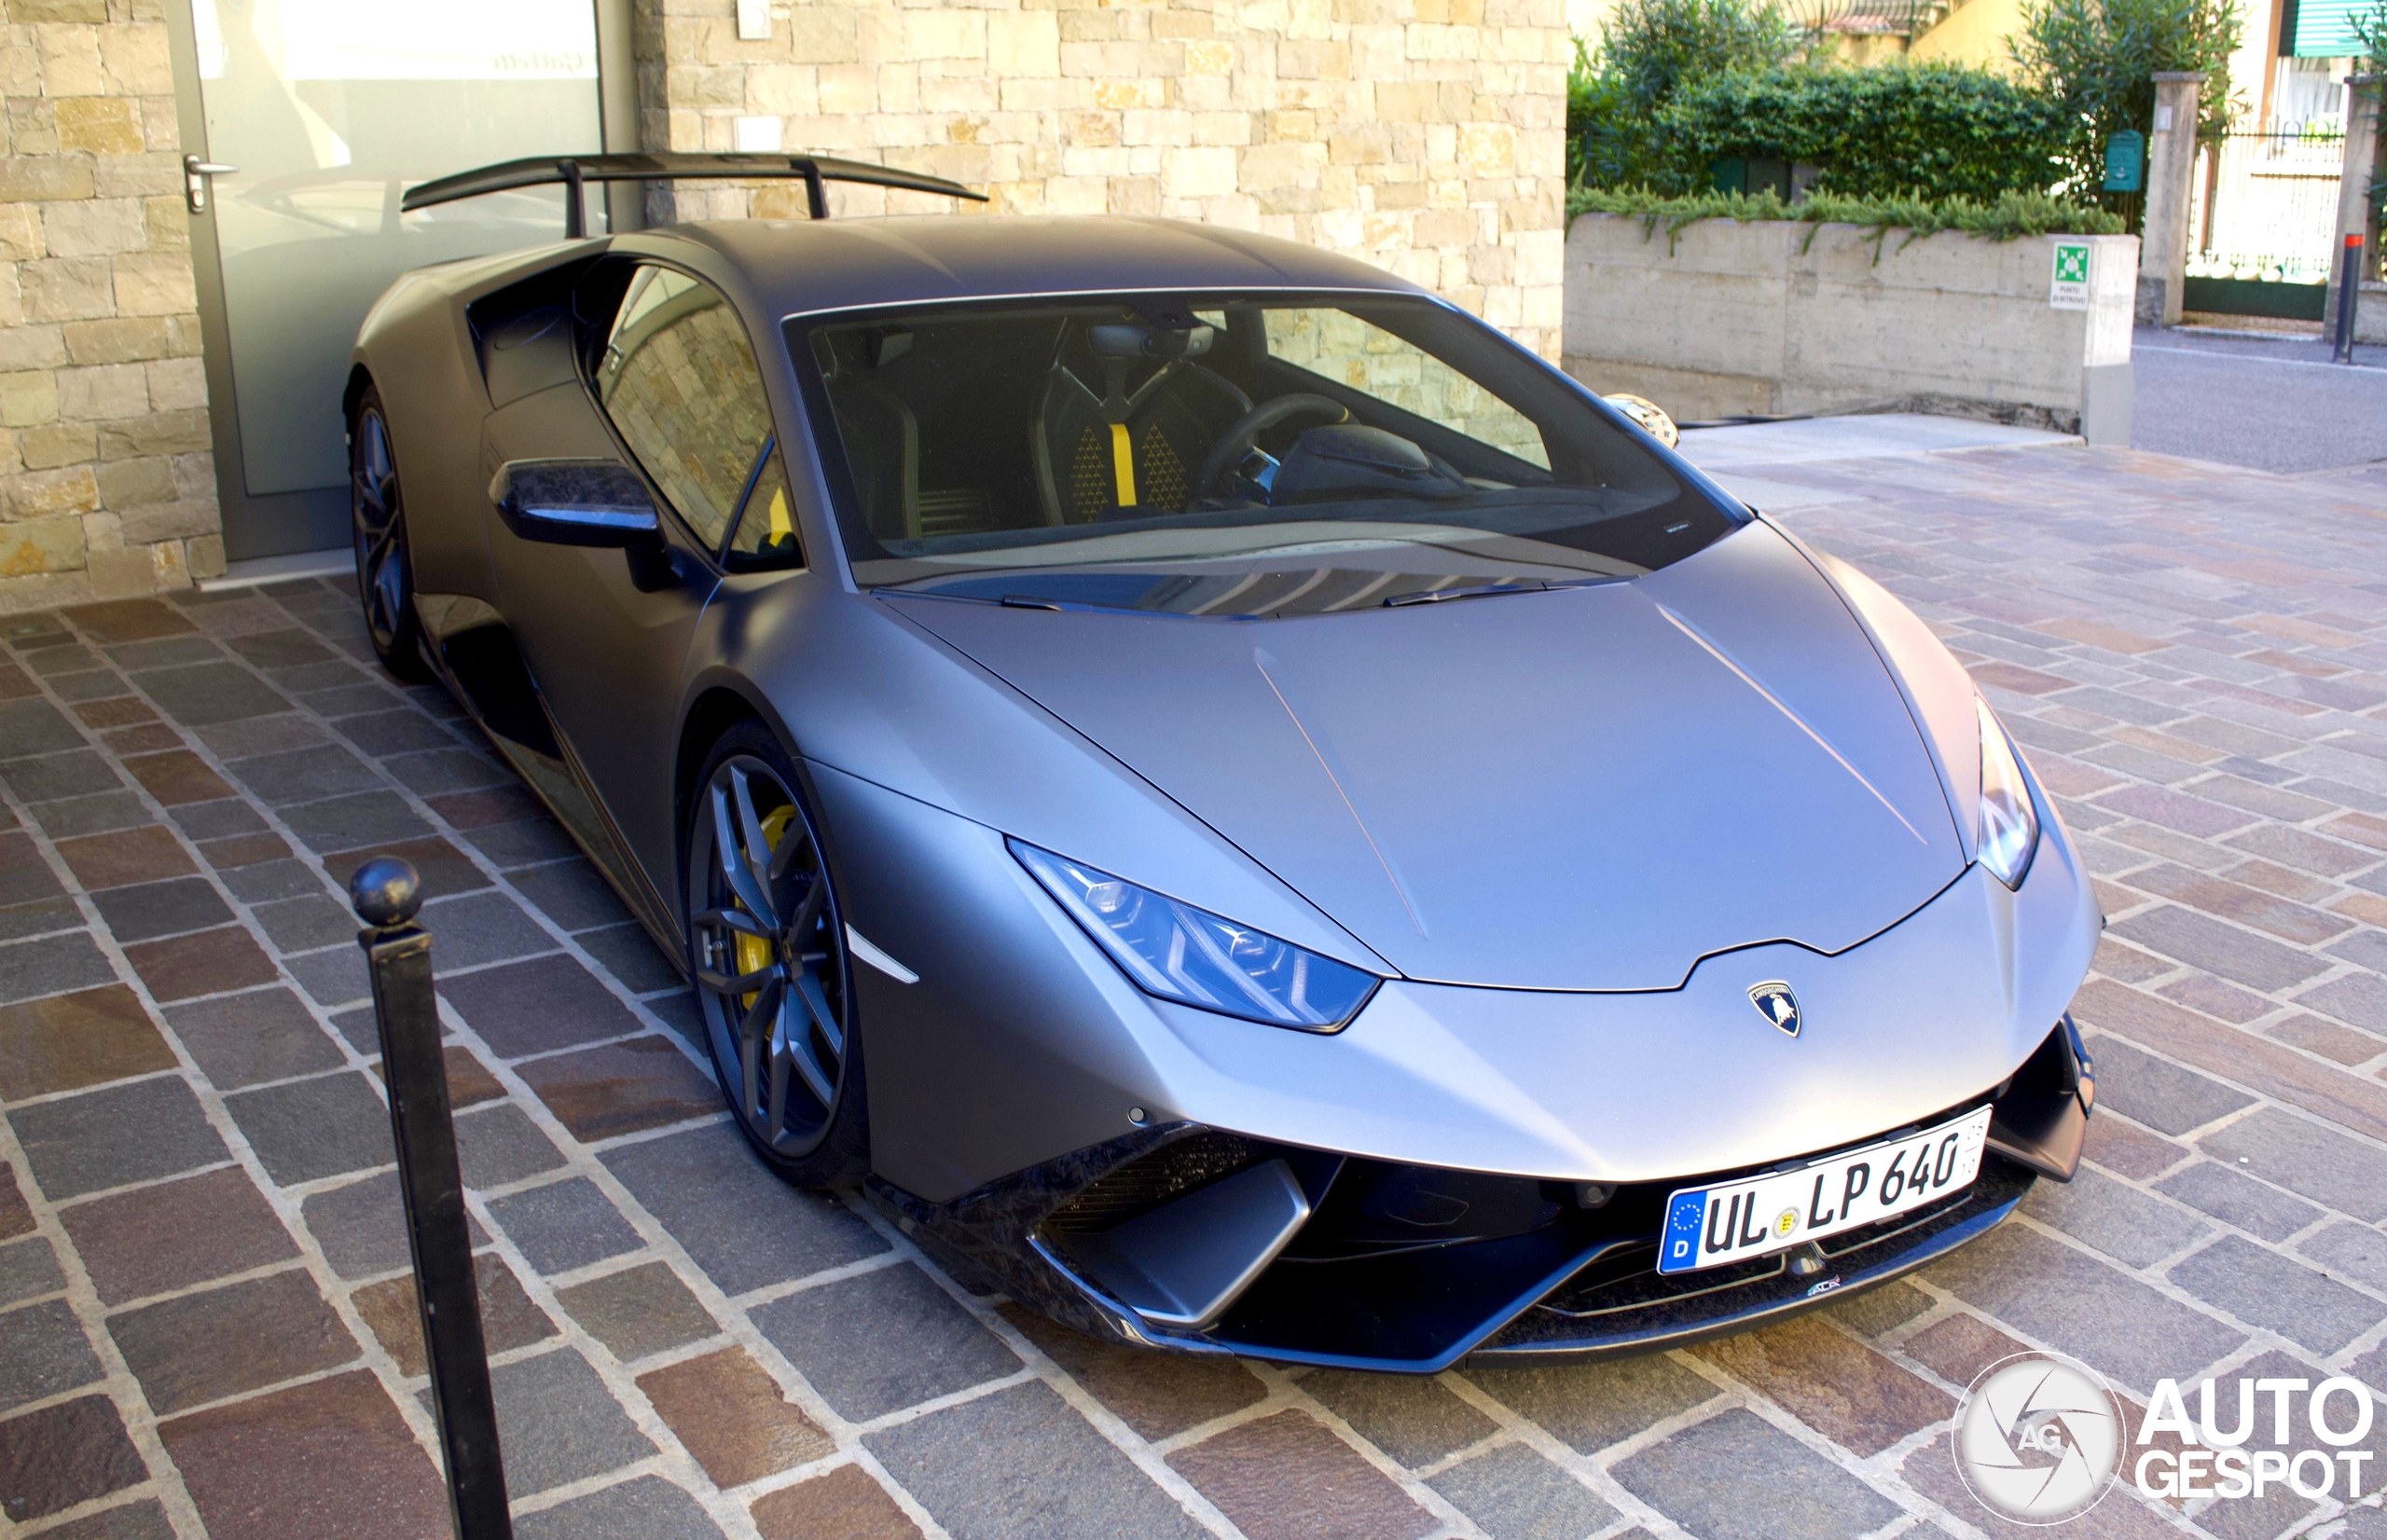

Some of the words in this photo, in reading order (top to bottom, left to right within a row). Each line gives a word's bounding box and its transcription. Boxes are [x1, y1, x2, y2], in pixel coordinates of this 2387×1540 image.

[2060, 285, 2080, 294] PUNTO
[2060, 296, 2086, 304] RITROVO
[1705, 1190, 1767, 1254] UL
[1807, 1162, 1870, 1229] LP
[1879, 1132, 1959, 1206] 640
[1673, 1240, 1689, 1258] D
